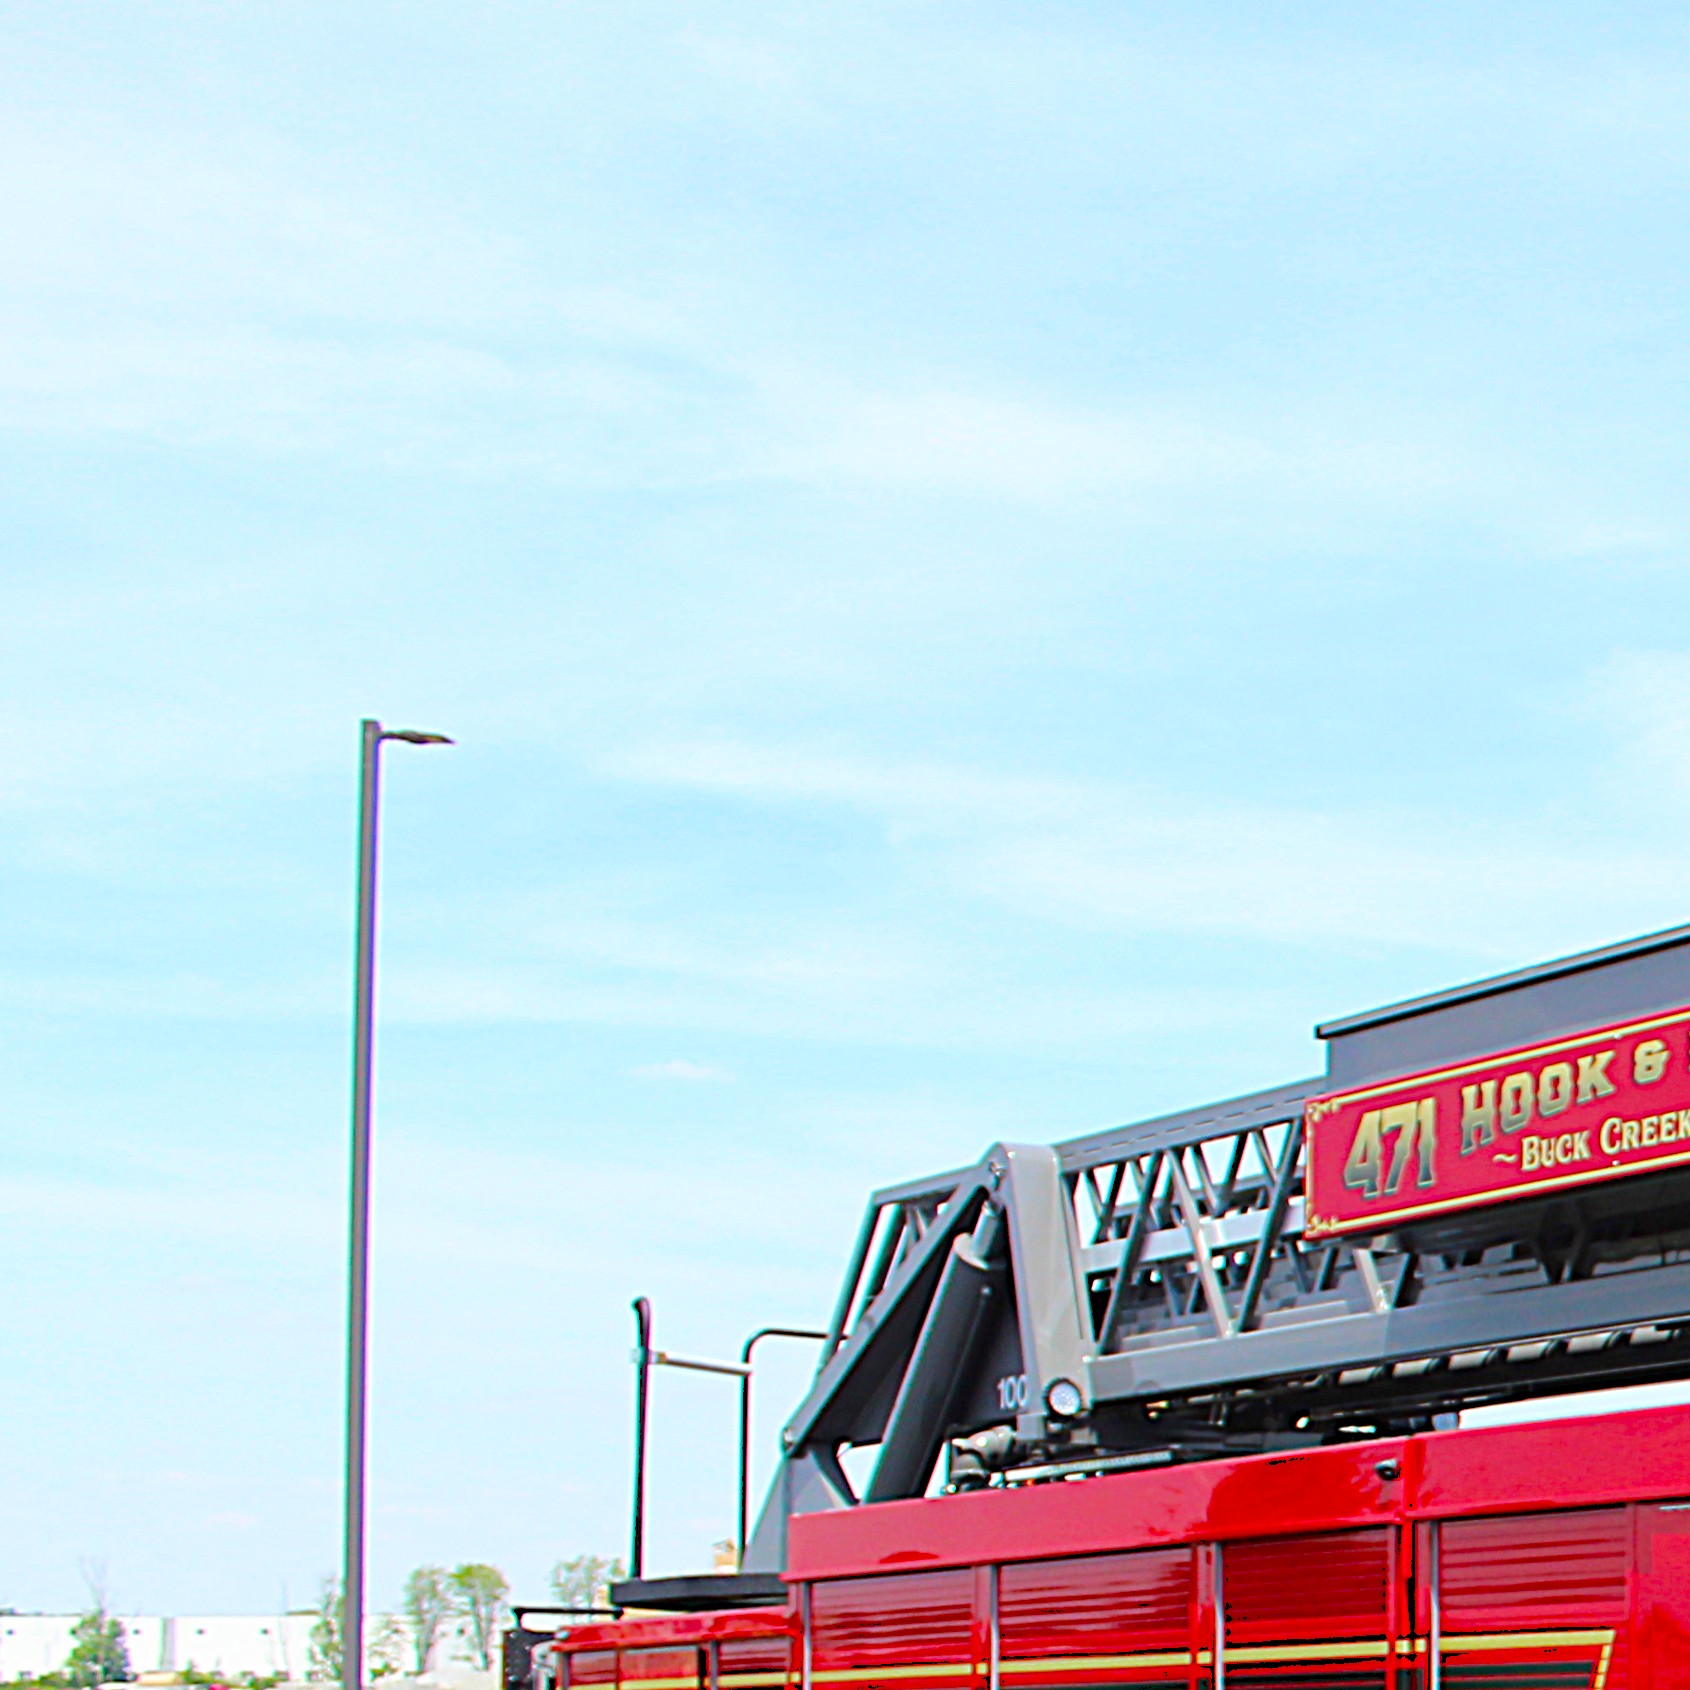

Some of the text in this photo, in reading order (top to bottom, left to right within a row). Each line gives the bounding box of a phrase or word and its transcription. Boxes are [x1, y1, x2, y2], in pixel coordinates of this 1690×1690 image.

[1343, 1096, 1436, 1199] 471
[1460, 1050, 1616, 1156] HOOK
[1633, 1038, 1670, 1085] &
